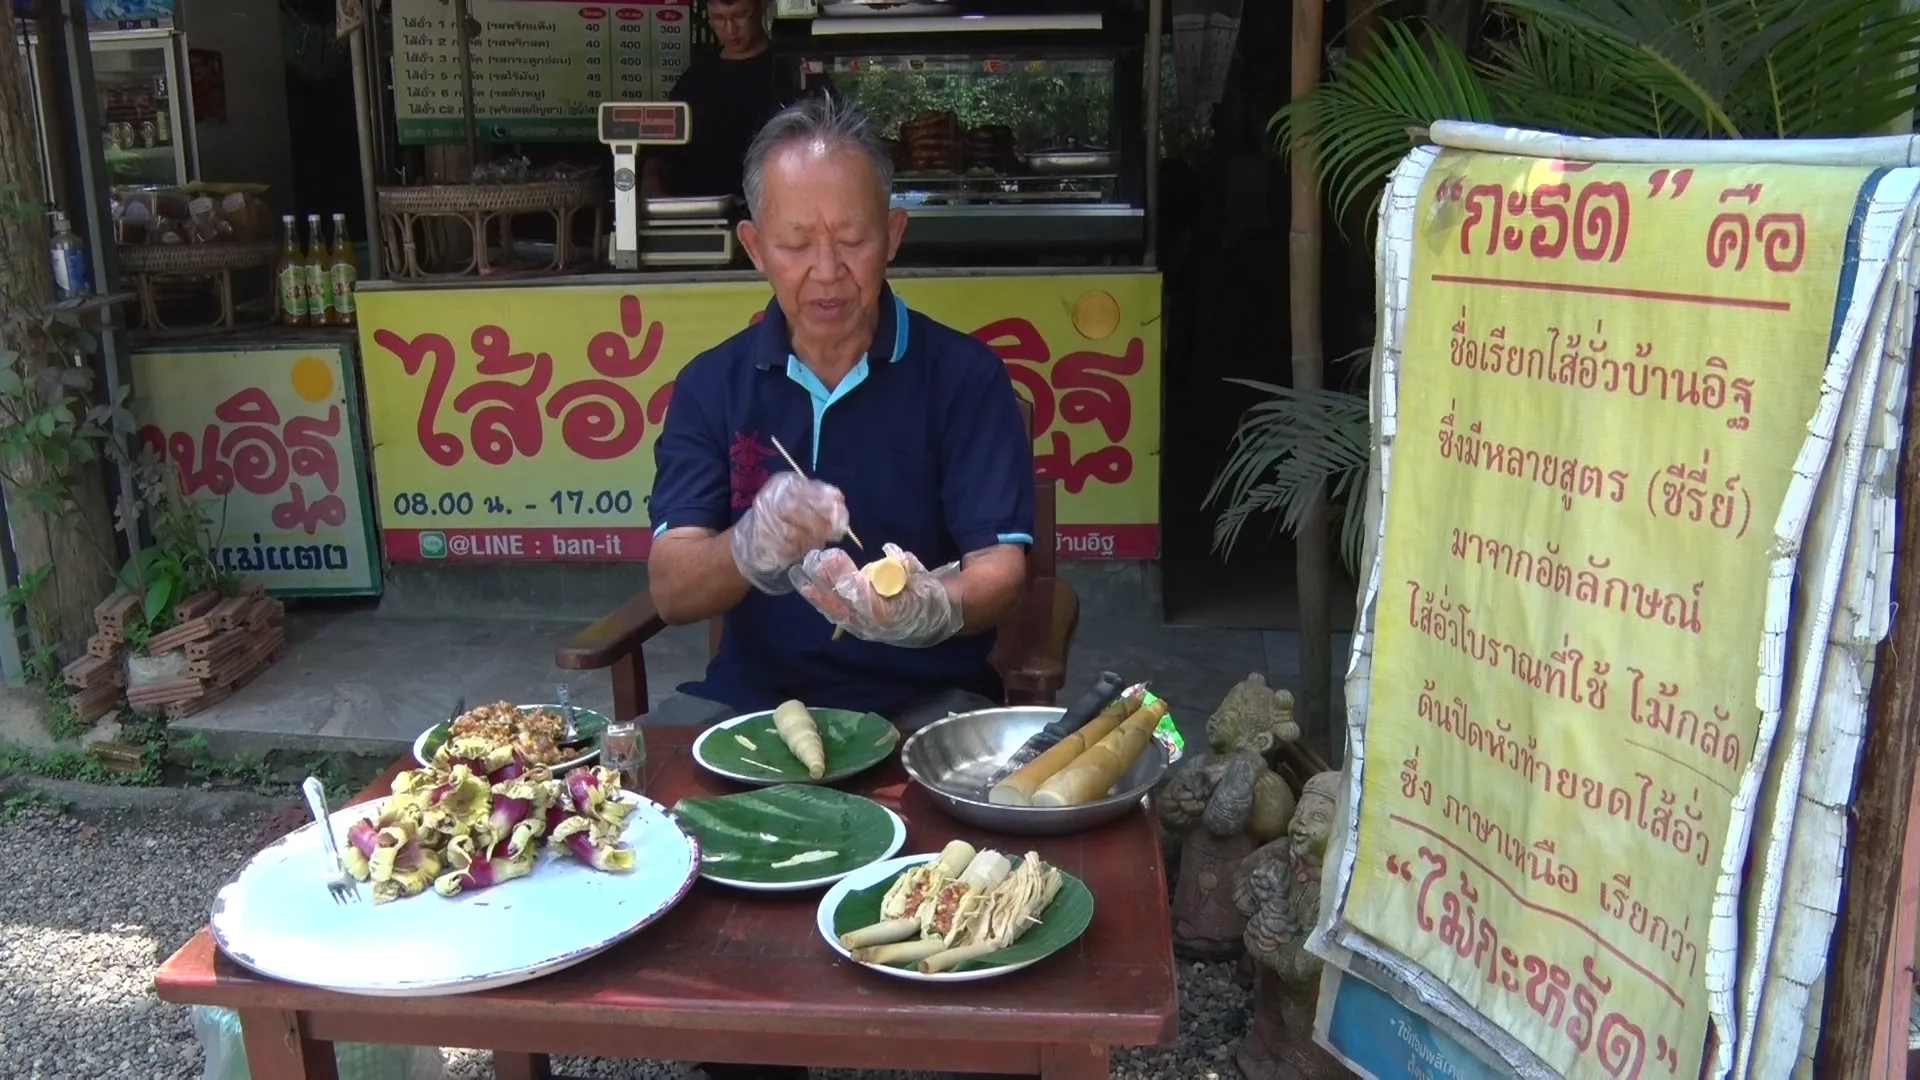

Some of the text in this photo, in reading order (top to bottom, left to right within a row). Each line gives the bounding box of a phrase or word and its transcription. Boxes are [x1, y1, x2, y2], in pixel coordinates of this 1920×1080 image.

[585, 24, 600, 32] 40
[620, 25, 641, 33] 400
[660, 25, 681, 34] 300
[438, 38, 447, 46] 2
[585, 40, 600, 48] 40
[620, 41, 641, 49] 400
[440, 55, 447, 63] 3
[586, 57, 601, 65] 40
[620, 57, 642, 66] 400
[586, 73, 601, 82] 45
[621, 74, 642, 82] 450
[587, 90, 602, 98] 45
[621, 91, 642, 99] 450
[1706, 183, 1805, 273] คือ
[1450, 305, 1755, 430] ชื่อเรียกไส้อั่วบ้านอิฐ
[1438, 398, 1751, 539] ซึ่งมีหลายสูตร (ซีรี่ย์)
[393, 492, 473, 516] 08.00
[483, 495, 513, 515] น.
[549, 490, 632, 515] 17.00
[449, 535, 525, 556] @LINE
[552, 535, 621, 556] ban-it
[1451, 527, 1704, 634] มาจากอัตลักษณ์
[1406, 580, 1741, 771] ไส้อั่วโบราณที่ใช้ ไม้กลัด
[1399, 745, 1698, 978] ซึ่ง ภาษาเหนือ เรียกว่า
